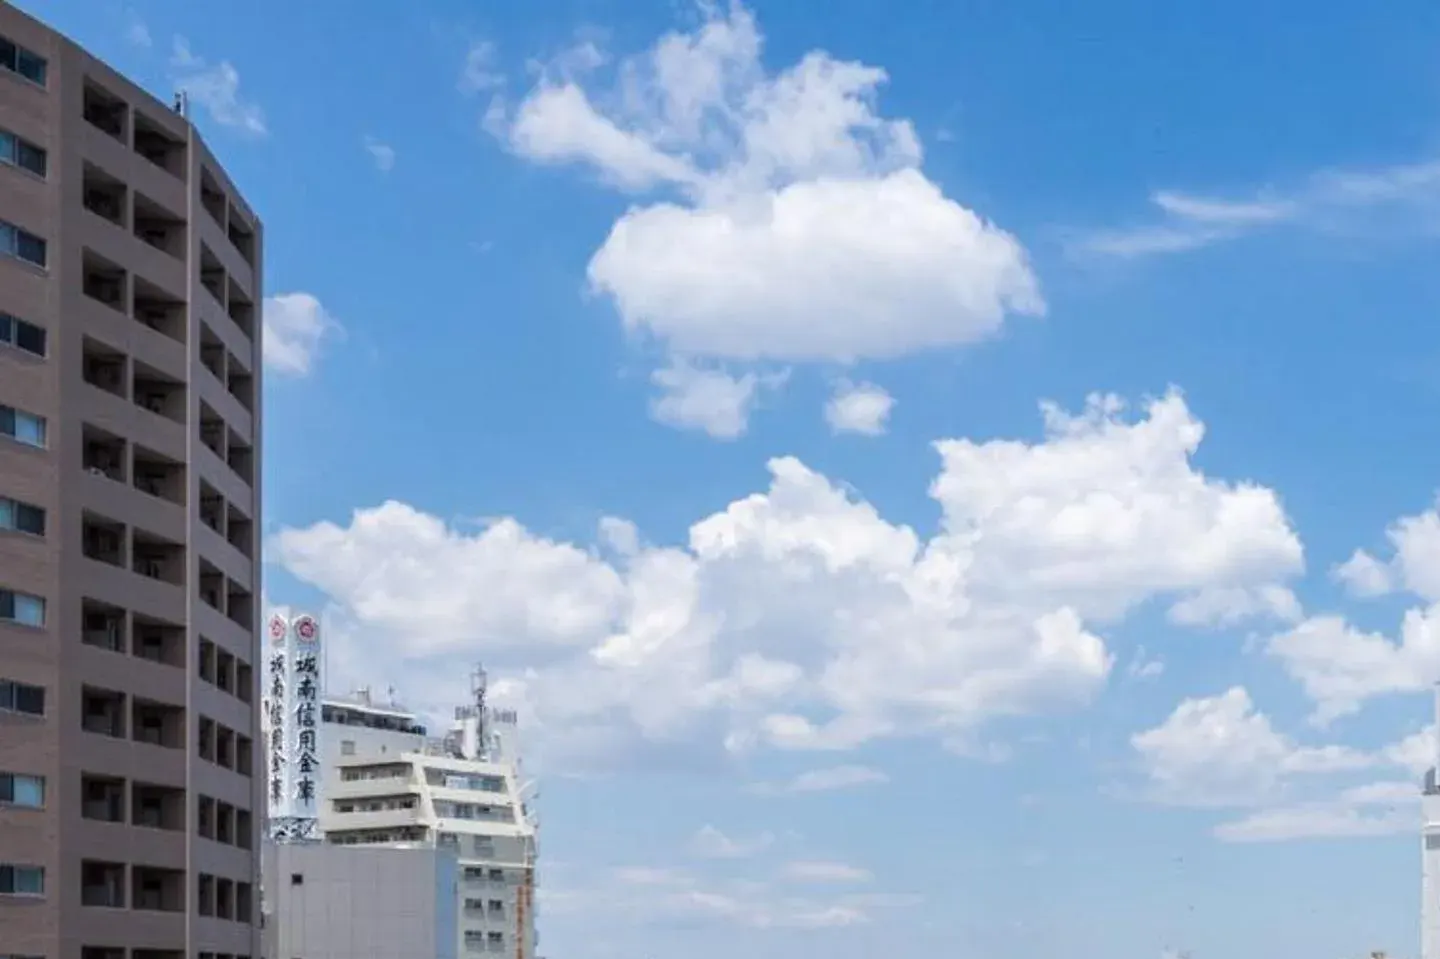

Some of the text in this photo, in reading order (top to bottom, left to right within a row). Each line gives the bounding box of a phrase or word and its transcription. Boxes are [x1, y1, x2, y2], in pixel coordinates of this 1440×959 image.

[295, 653, 319, 806] 城南信用金庫
